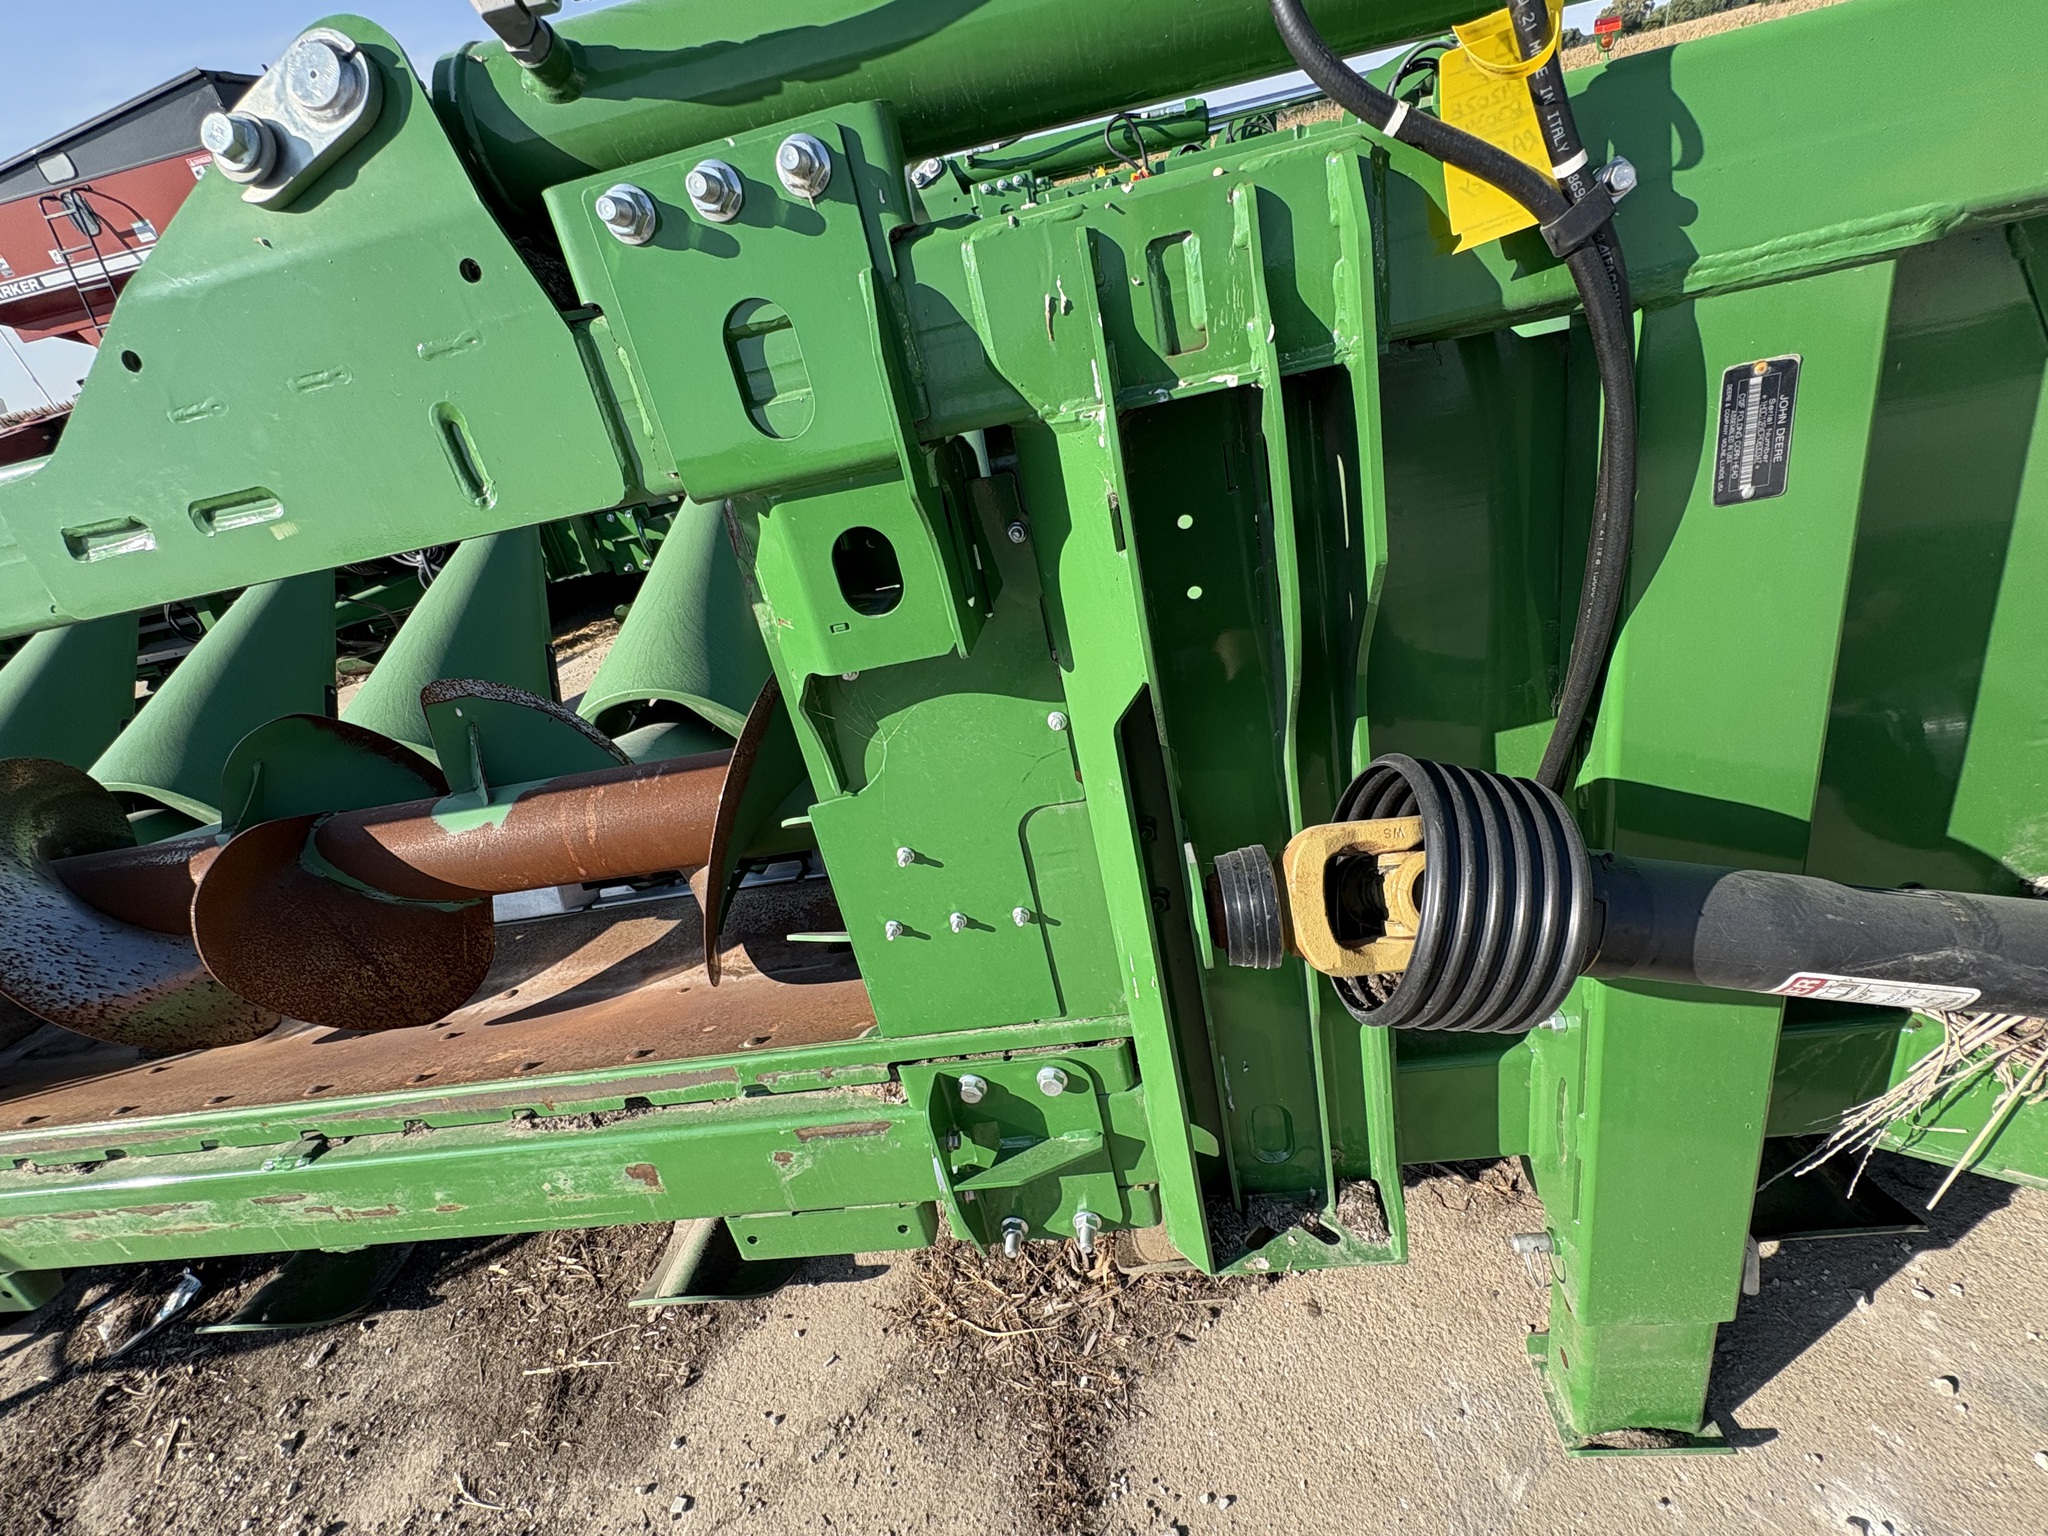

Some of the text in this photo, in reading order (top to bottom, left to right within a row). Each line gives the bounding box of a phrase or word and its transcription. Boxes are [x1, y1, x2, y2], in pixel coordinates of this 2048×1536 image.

[1521, 12, 1537, 32] 21
[1528, 39, 1549, 80] ME
[1539, 85, 1556, 105] IN
[1547, 112, 1570, 154] ITALY
[1725, 383, 1733, 402] DEERE
[1735, 411, 1745, 439] FOLDING
[1763, 397, 1776, 463] Serial Number
[1773, 394, 1789, 463] JOHN DEERE
[1733, 440, 1742, 460] CORN
[1731, 460, 1739, 479] HEAD
